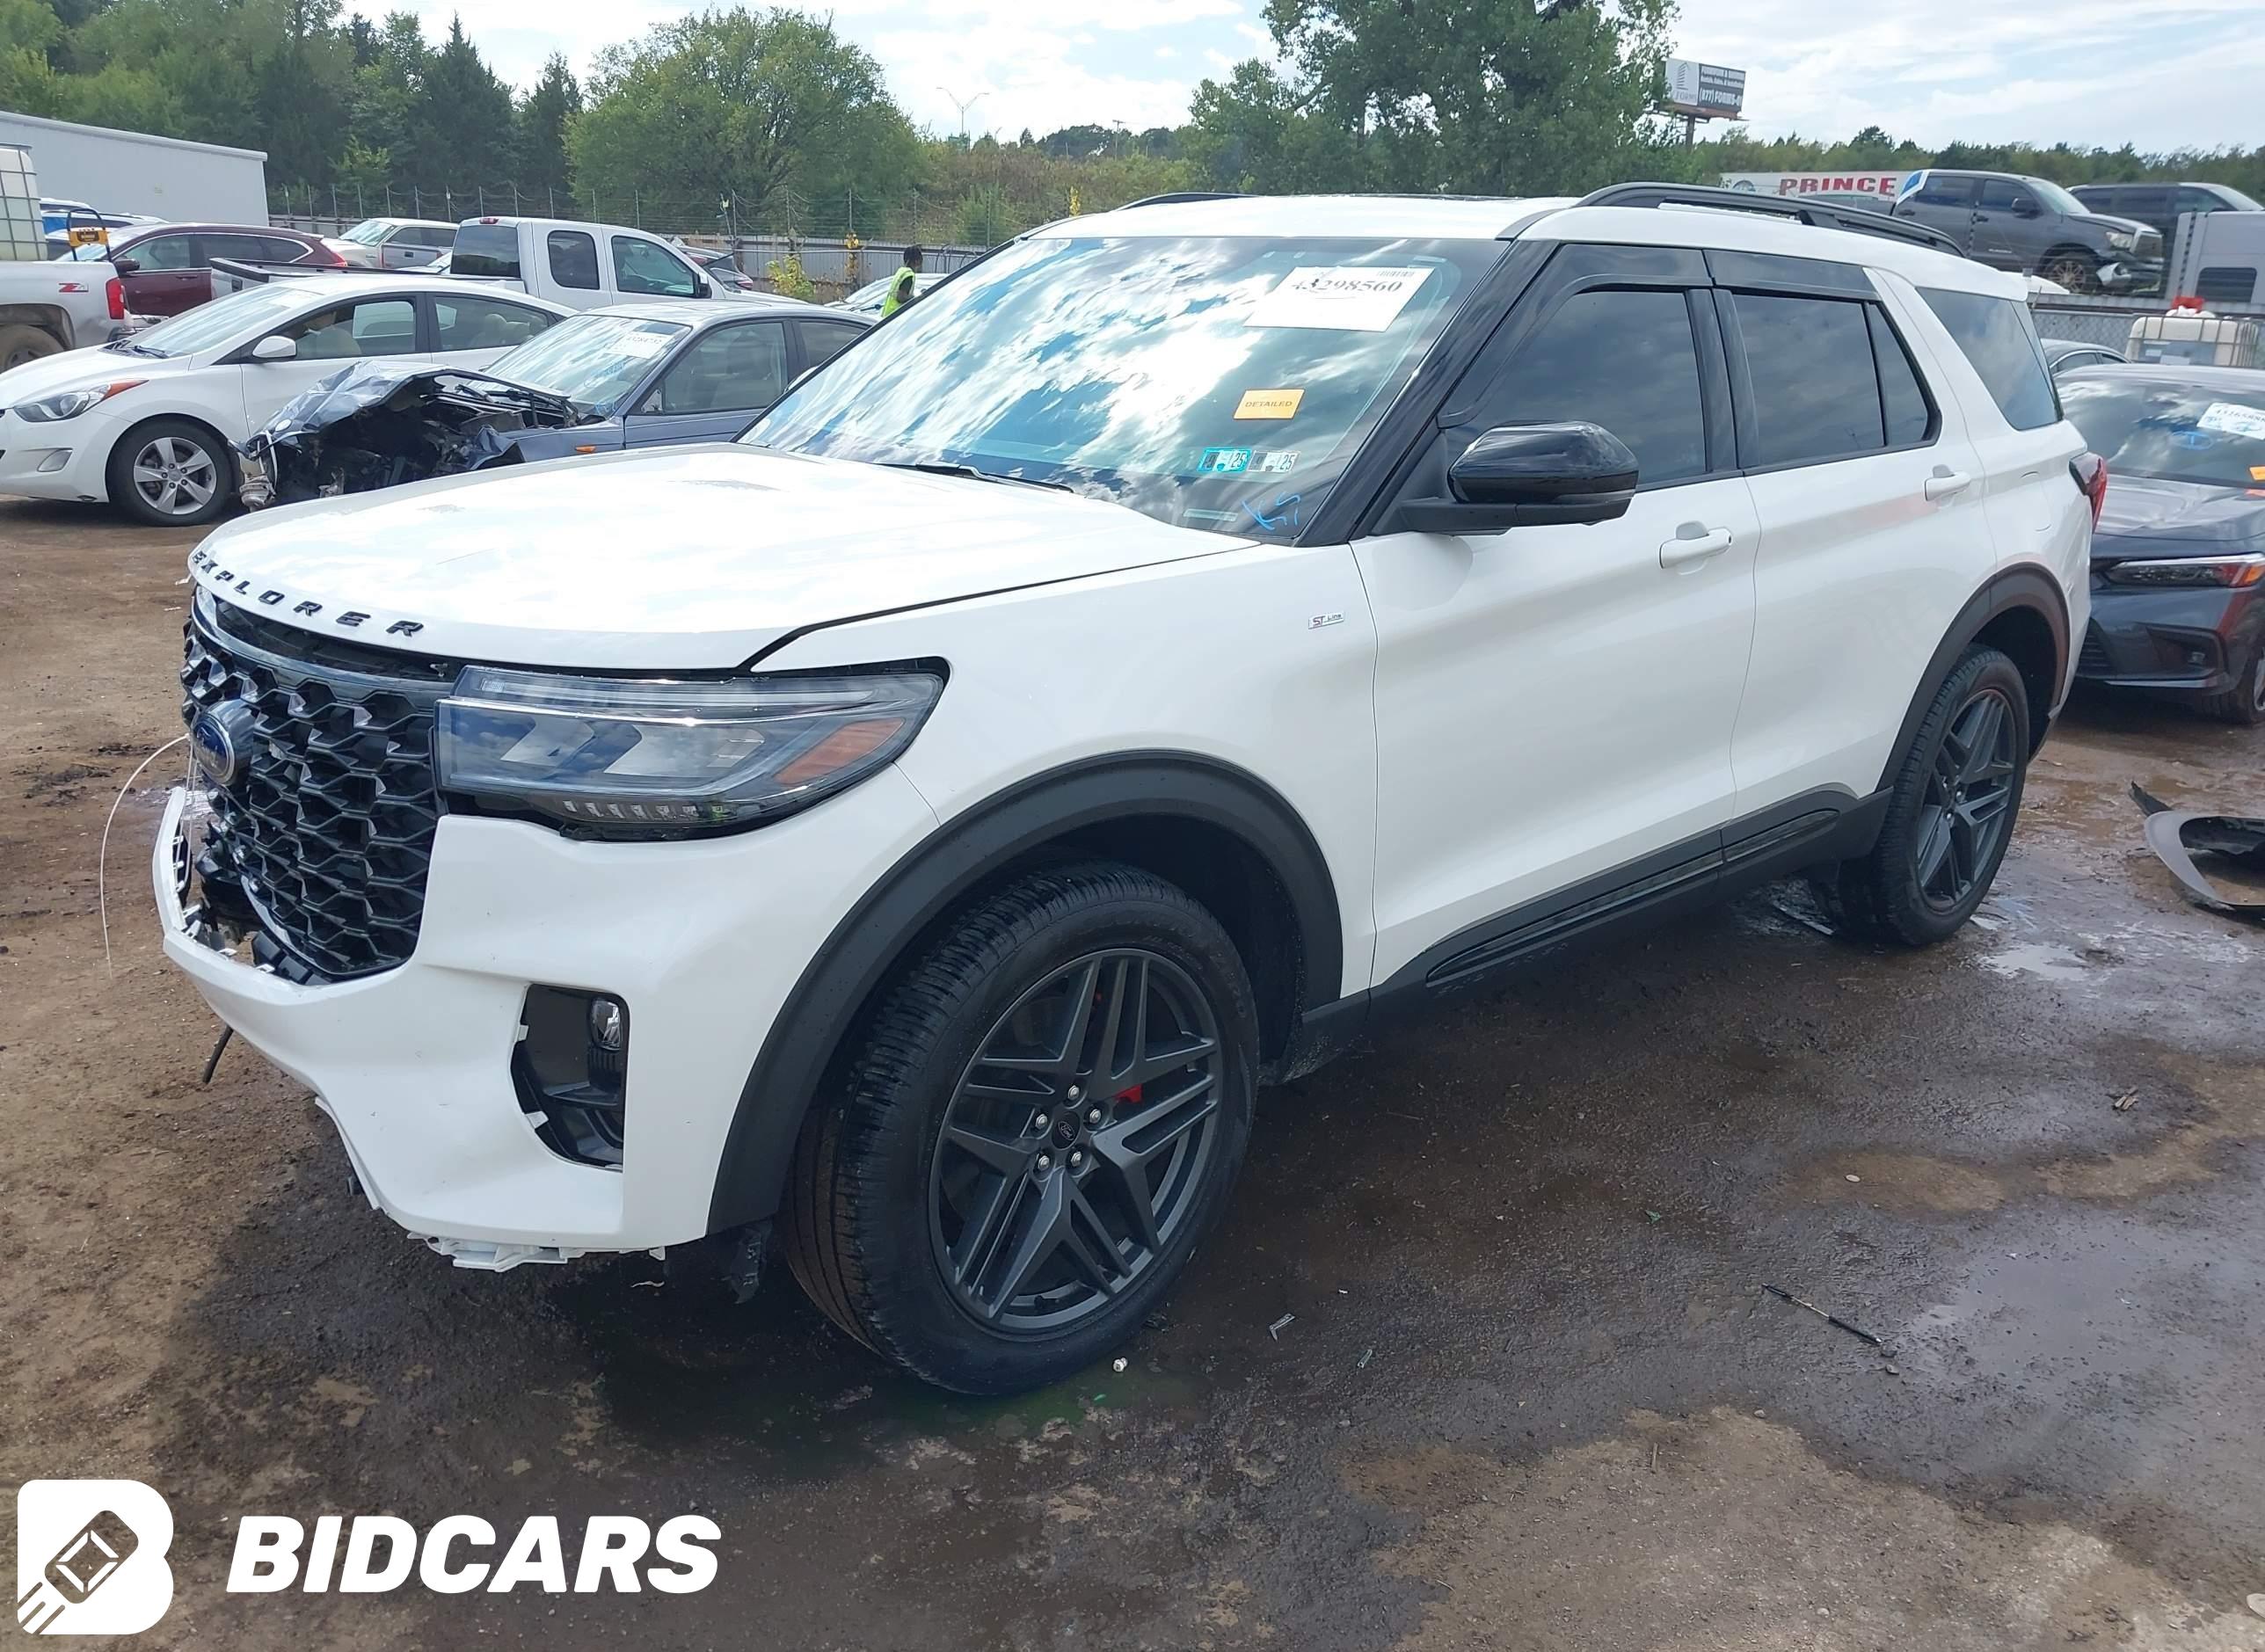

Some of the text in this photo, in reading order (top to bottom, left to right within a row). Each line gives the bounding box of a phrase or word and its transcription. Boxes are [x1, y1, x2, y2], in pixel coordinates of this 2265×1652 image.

[1779, 178, 1897, 197] PRINCE
[1232, 453, 1247, 469] 25
[1280, 455, 1295, 470] 25
[192, 550, 425, 637] EXPLORER
